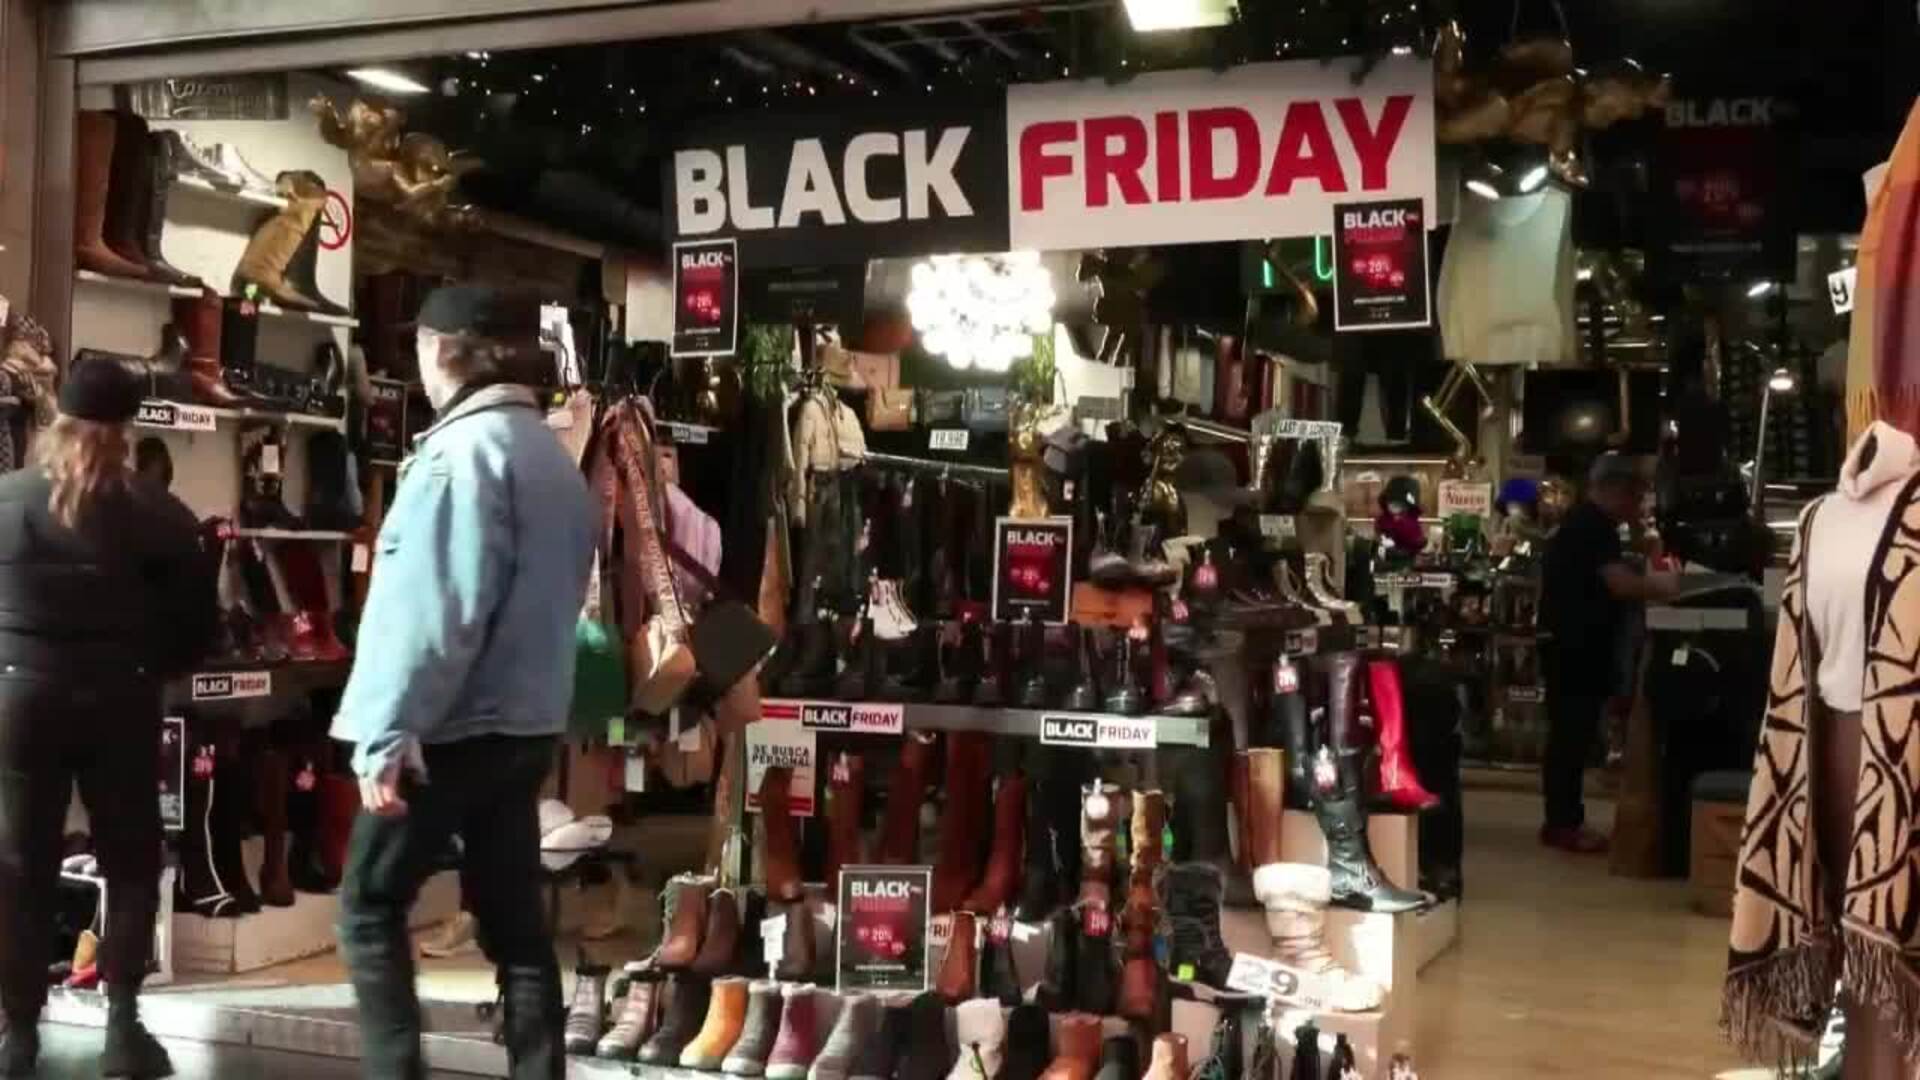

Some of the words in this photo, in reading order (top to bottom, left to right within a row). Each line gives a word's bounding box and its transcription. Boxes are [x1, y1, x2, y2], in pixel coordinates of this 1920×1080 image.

[675, 126, 974, 235] BLACK
[1020, 95, 1414, 212] FRIDAY
[1344, 208, 1406, 229] BLACK
[682, 252, 724, 269] BLACK
[1007, 530, 1056, 546] BLACK
[197, 679, 229, 693] BLACK
[803, 708, 848, 726] BLACK
[852, 711, 899, 727] FRIDAY
[1046, 722, 1094, 739] BLACK
[1100, 725, 1151, 740] FRIDAY
[851, 881, 910, 898] BLACK
